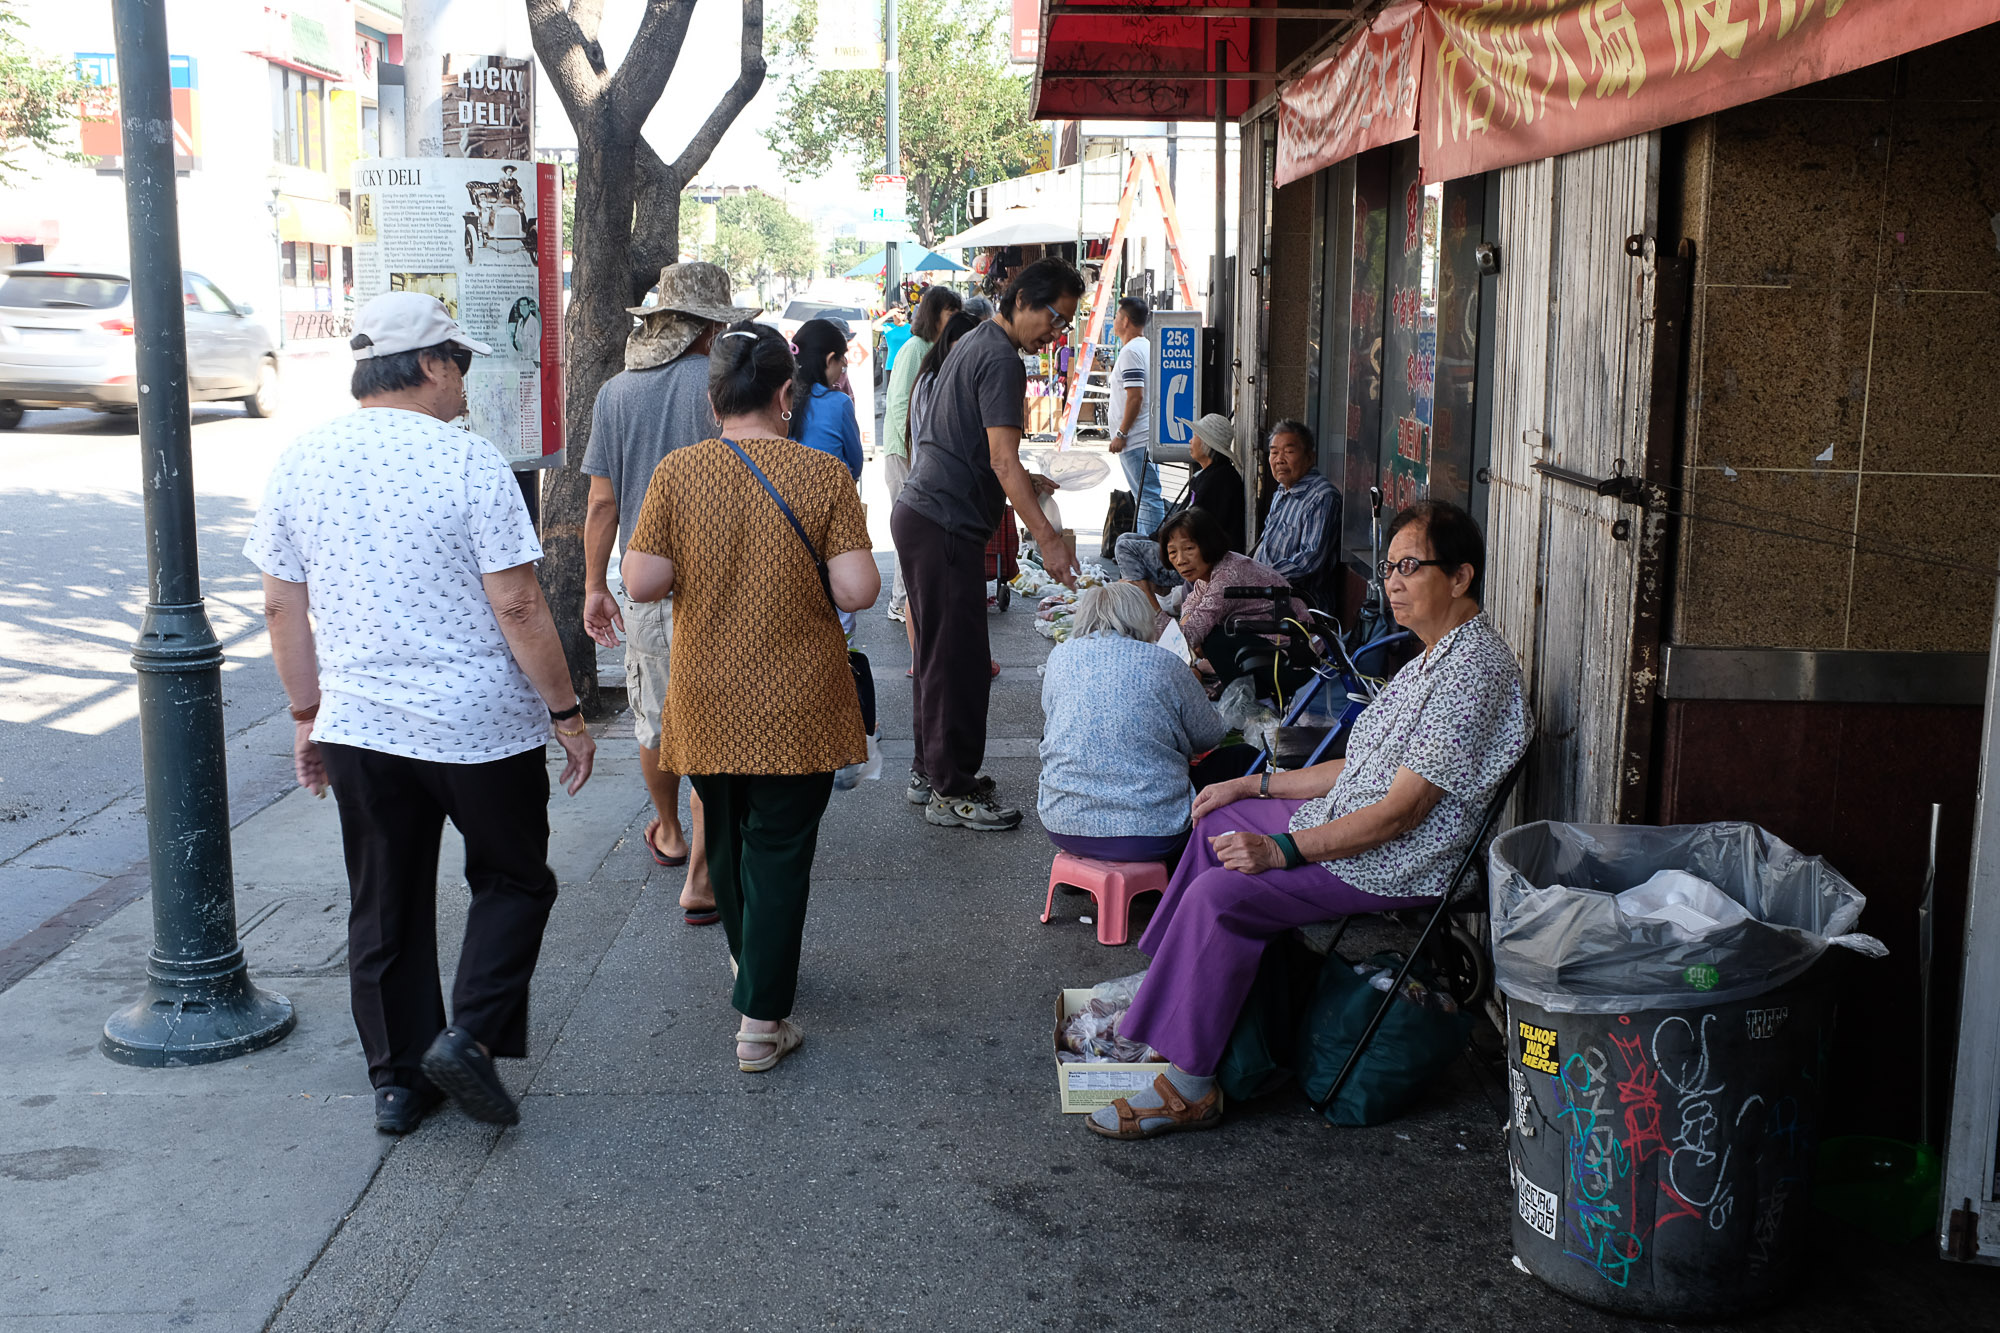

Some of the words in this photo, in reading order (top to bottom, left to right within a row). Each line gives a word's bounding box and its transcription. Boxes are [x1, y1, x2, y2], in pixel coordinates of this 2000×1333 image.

[458, 67, 523, 93] LUCKY
[458, 101, 505, 126] DELI
[388, 169, 421, 186] DELI
[1167, 331, 1189, 346] 25¢
[1162, 349, 1193, 358] LOCAL
[1163, 360, 1192, 369] CALLS
[1519, 1022, 1557, 1046] TELKOE
[1526, 1040, 1550, 1059] WAS
[1522, 1053, 1559, 1074] HERE
